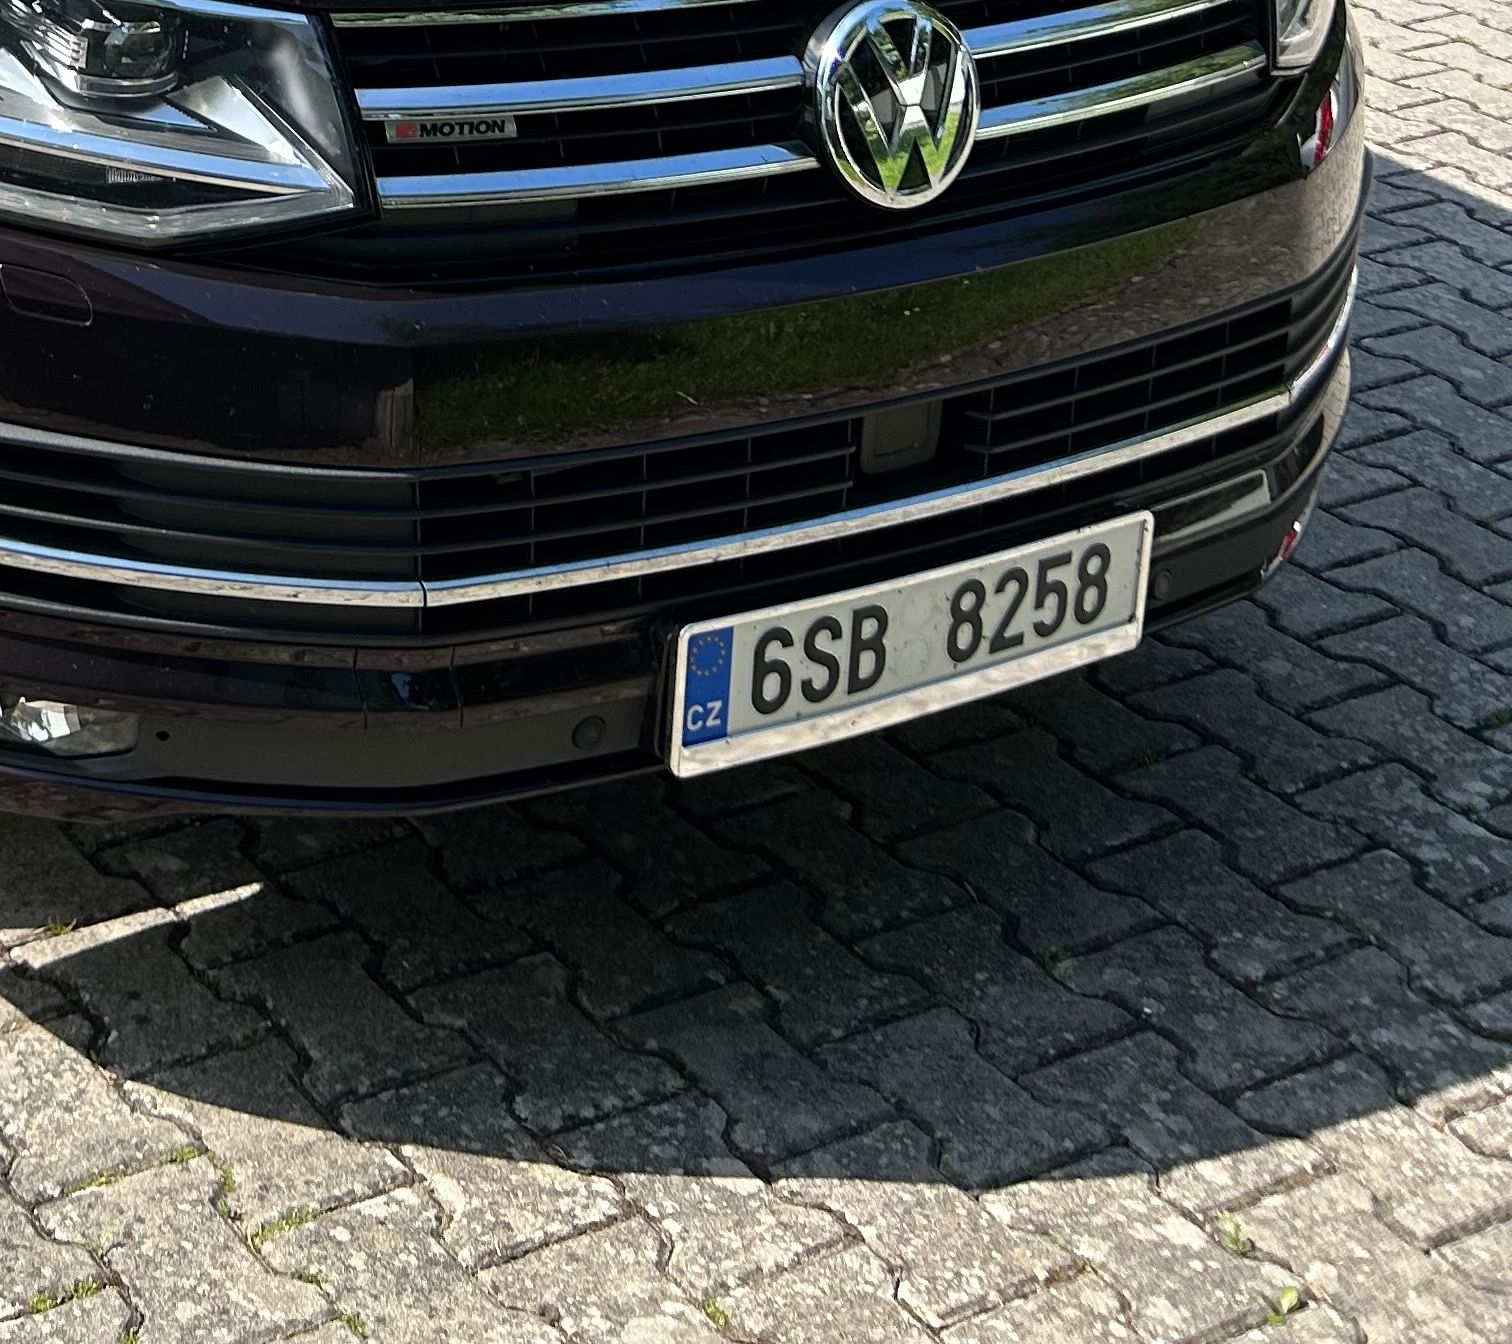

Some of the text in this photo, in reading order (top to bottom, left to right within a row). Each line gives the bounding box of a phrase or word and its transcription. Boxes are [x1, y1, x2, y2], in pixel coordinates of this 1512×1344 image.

[750, 542, 1111, 714] 6SB 8258
[687, 699, 722, 731] CZ
